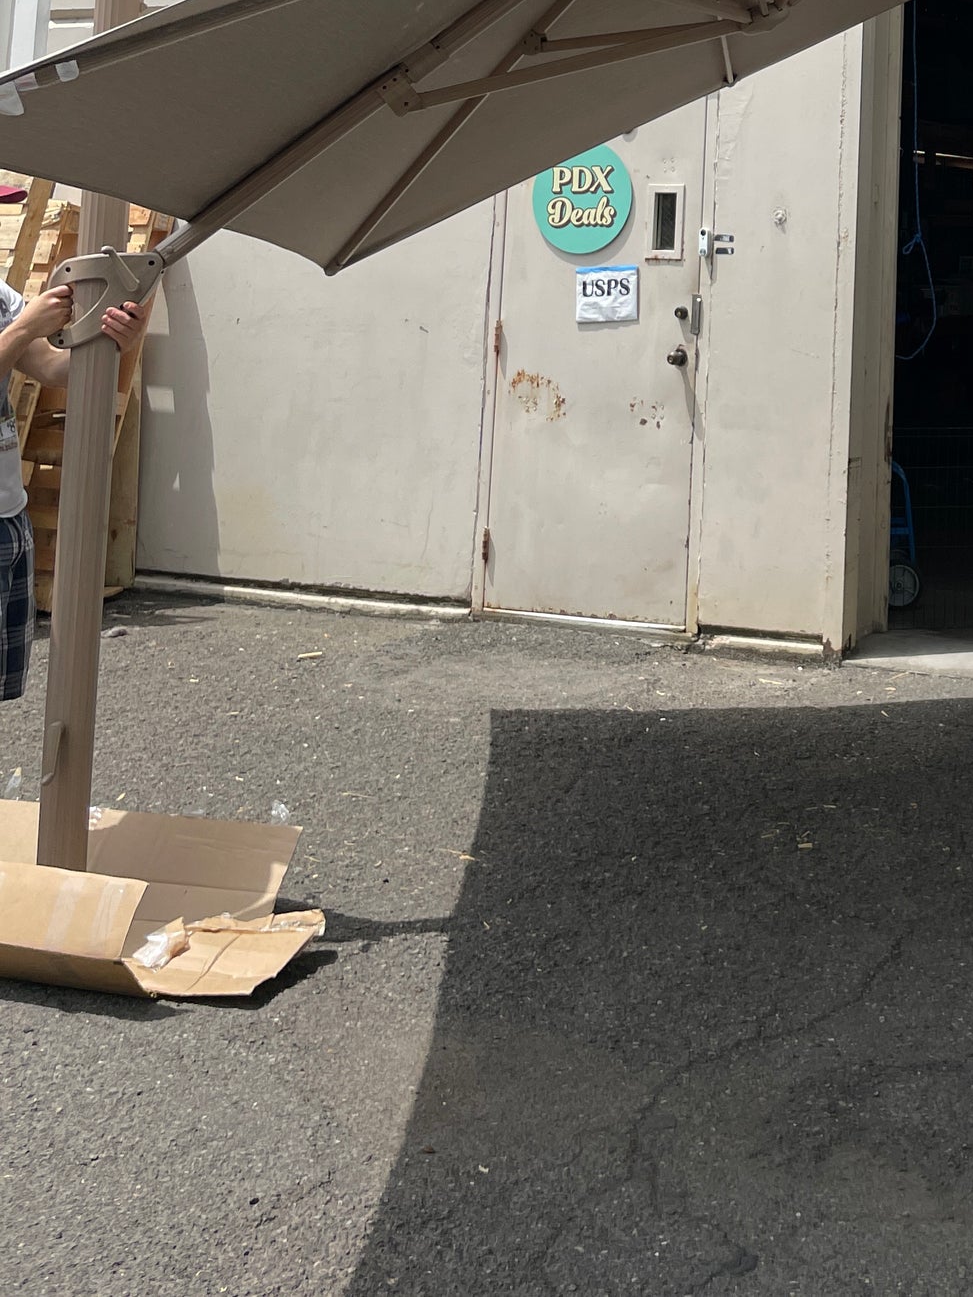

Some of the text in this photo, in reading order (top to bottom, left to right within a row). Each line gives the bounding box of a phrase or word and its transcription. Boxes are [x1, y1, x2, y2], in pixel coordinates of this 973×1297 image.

[552, 165, 615, 194] PDX
[547, 196, 617, 228] Deals
[582, 278, 631, 298] USPS
